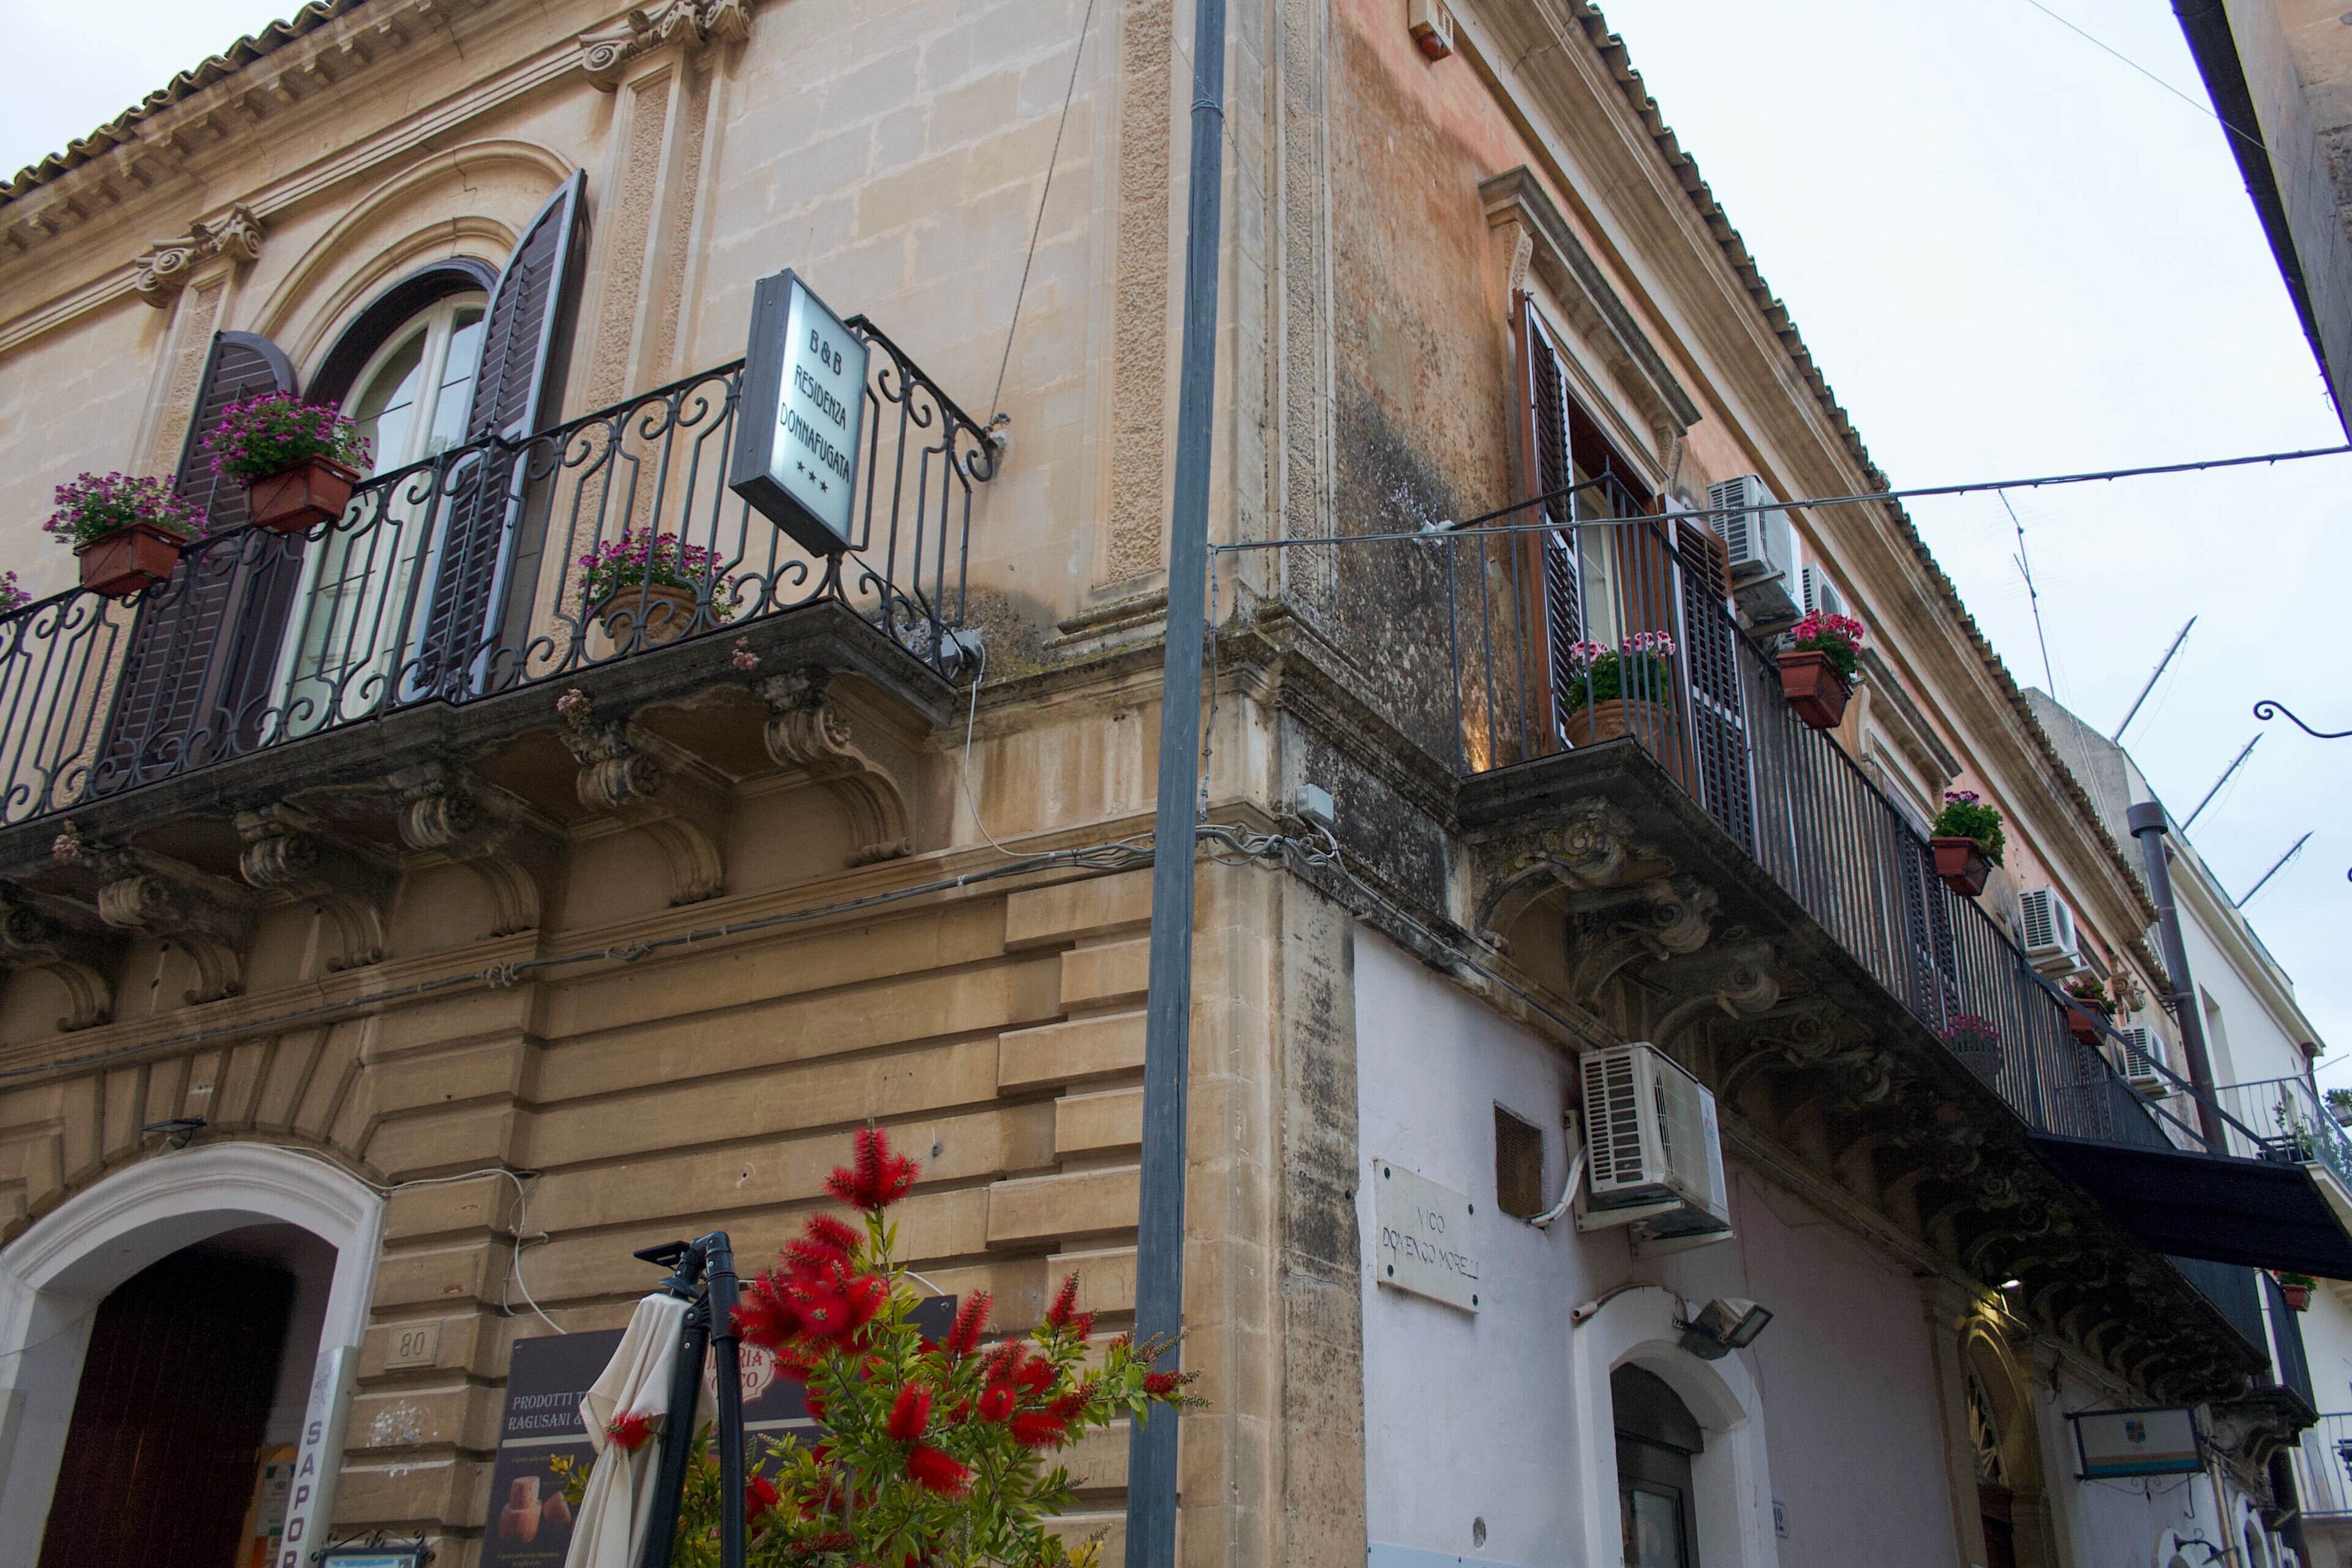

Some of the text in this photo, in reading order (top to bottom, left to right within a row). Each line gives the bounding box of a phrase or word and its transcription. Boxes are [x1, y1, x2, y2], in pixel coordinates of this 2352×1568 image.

[810, 329, 842, 375] B&B
[795, 364, 846, 431] RESIDENZA
[780, 402, 850, 483] DONNAFUGATA
[400, 1331, 425, 1357] 80
[513, 1392, 573, 1409] PRODOTTI
[508, 1412, 571, 1431] RAGUSANI
